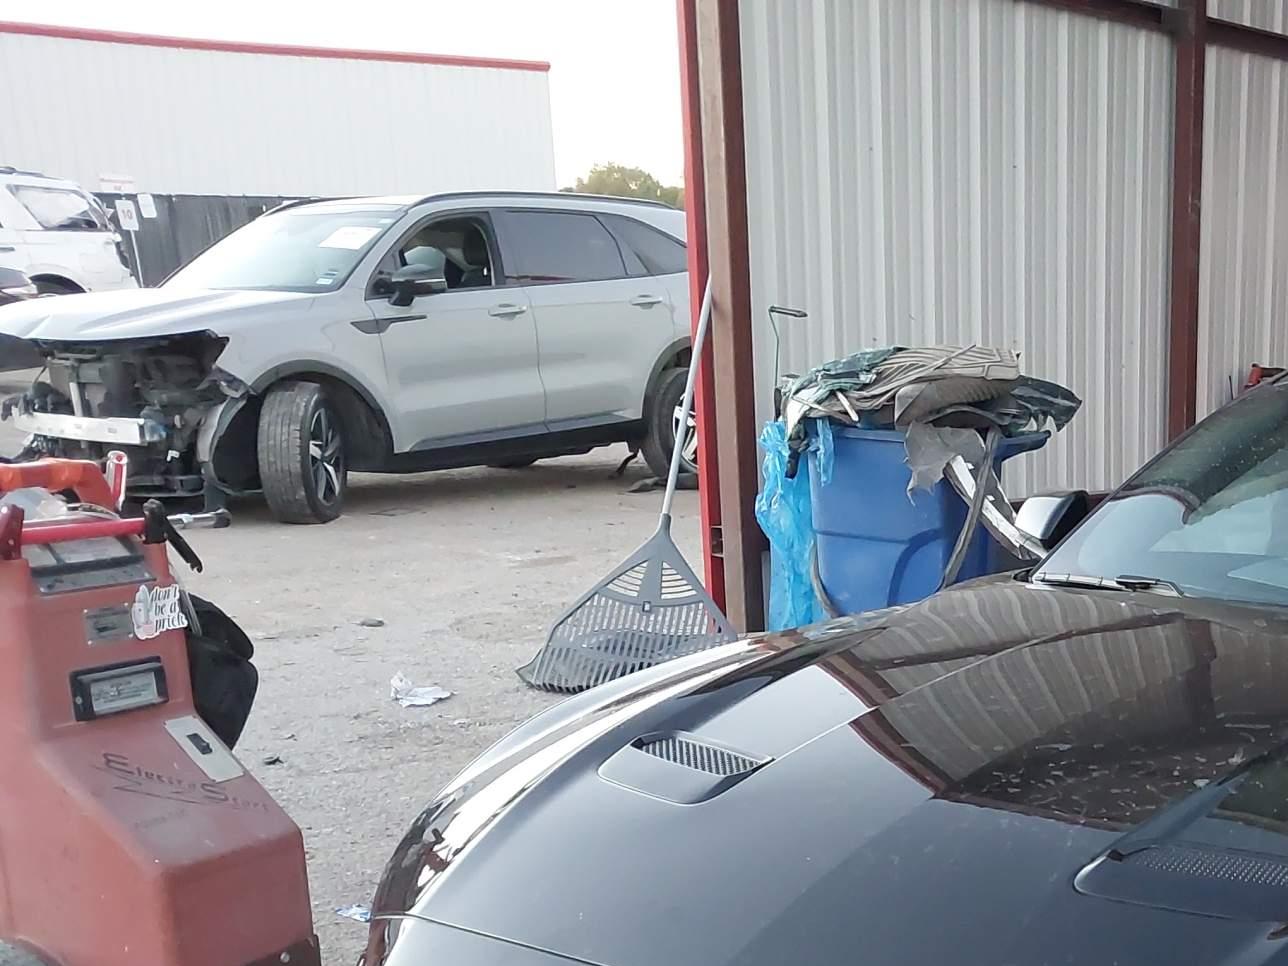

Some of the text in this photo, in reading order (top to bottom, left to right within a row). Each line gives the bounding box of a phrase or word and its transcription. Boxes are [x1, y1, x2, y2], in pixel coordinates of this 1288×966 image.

[154, 602, 177, 616] be a
[155, 613, 185, 633] prick
